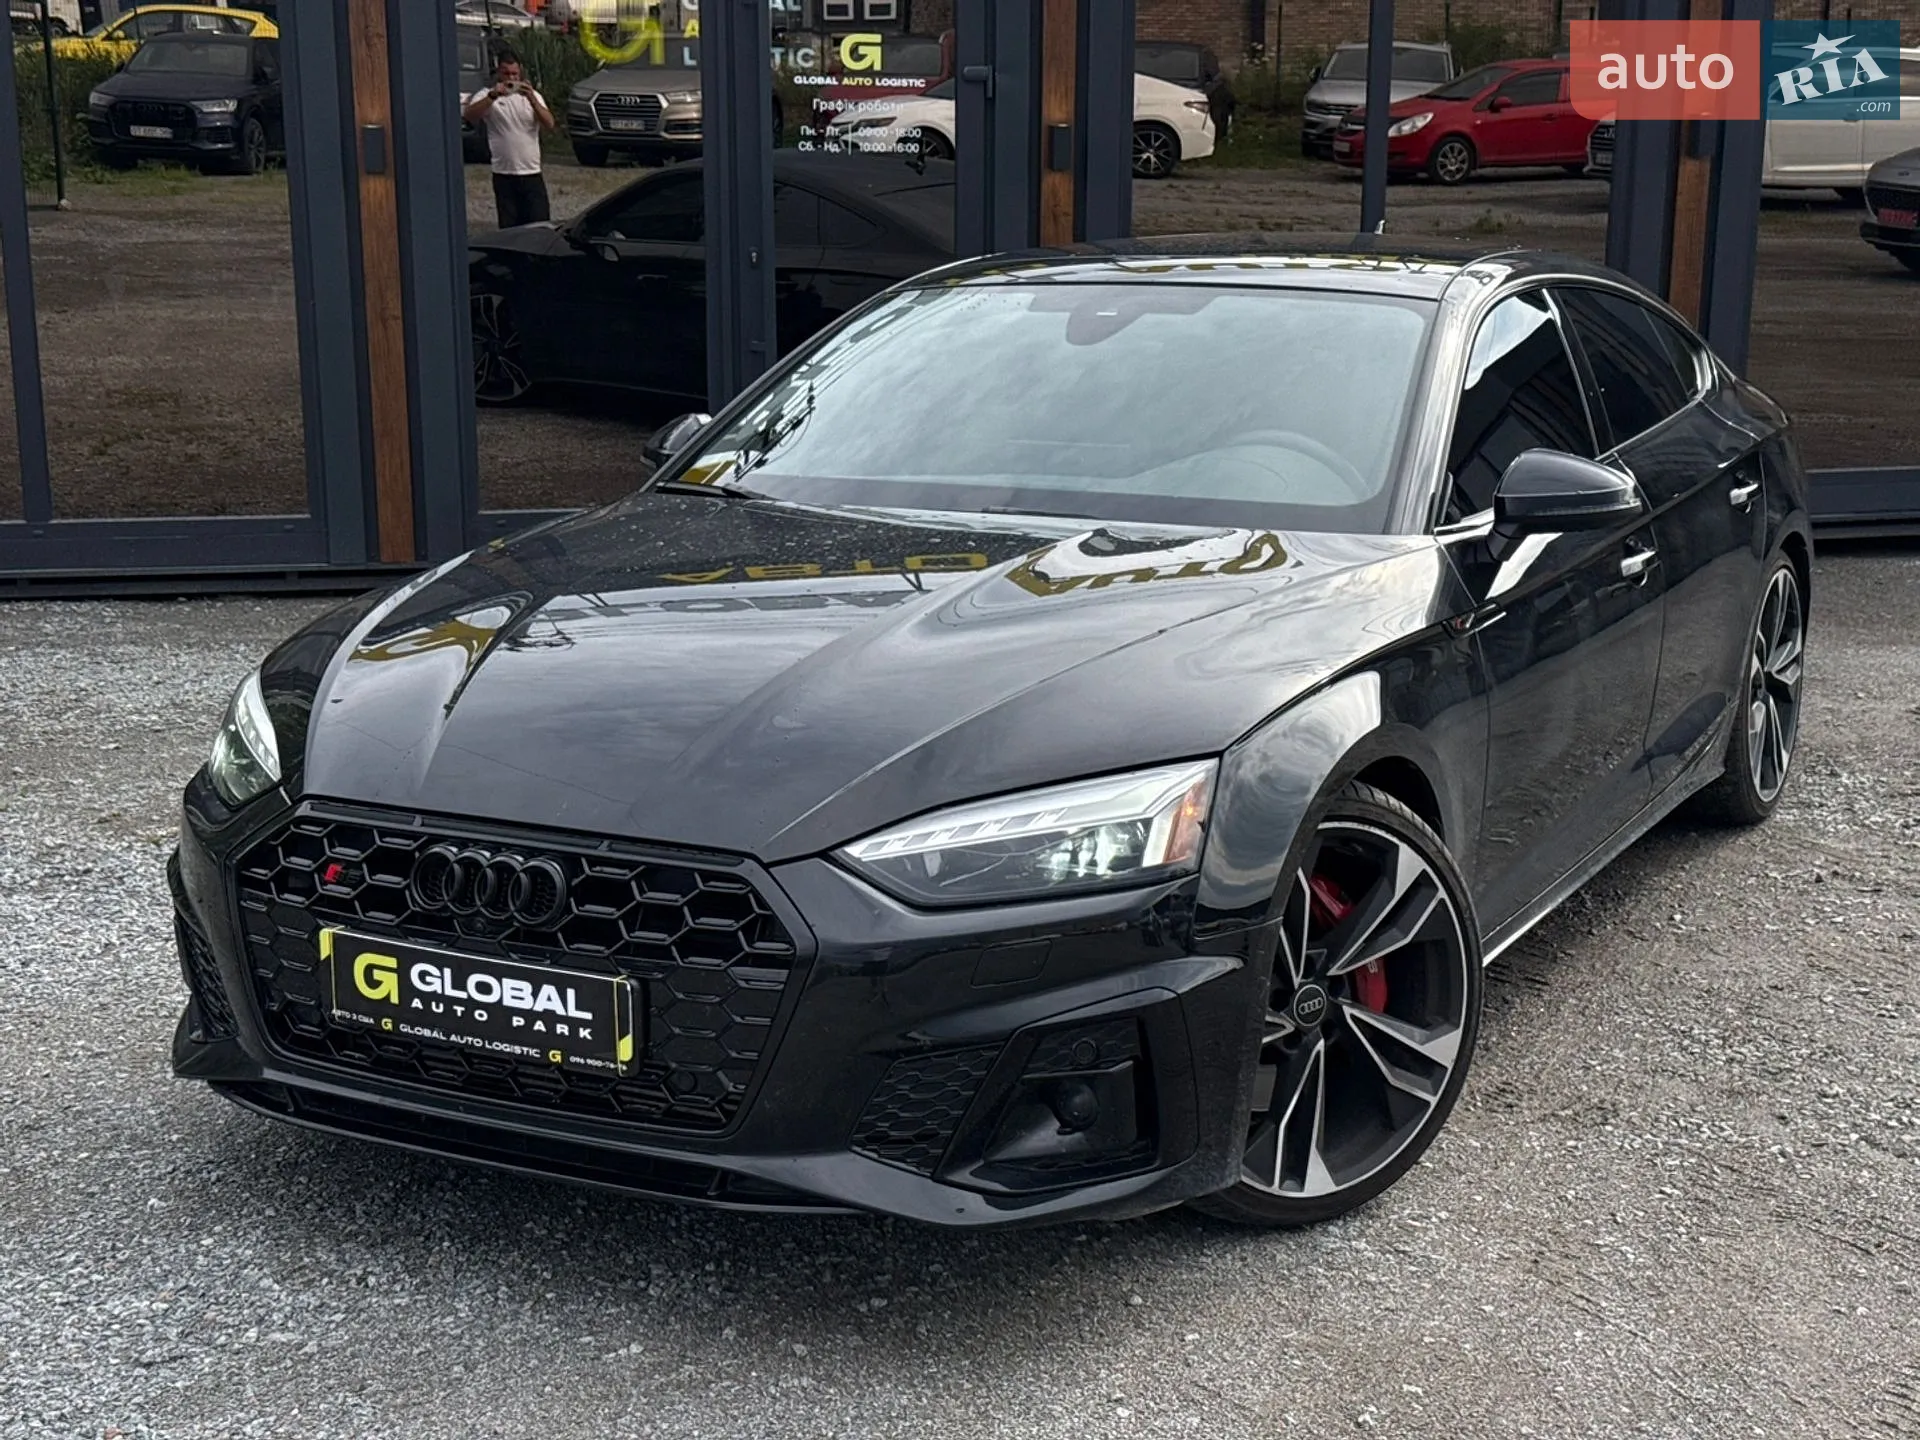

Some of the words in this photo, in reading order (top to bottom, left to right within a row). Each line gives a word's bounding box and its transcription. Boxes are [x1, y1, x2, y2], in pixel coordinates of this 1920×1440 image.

[793, 75, 839, 86] GLOBAL
[841, 77, 873, 87] AUTO
[875, 77, 927, 88] LOGISTIC
[812, 98, 855, 113] Графік
[410, 962, 593, 1021] GLOBAL
[410, 997, 488, 1021] AUTO
[511, 1015, 593, 1040] PARK
[399, 1023, 449, 1041] GLOBAL
[449, 1033, 483, 1047] AUTO
[484, 1038, 541, 1058] LOGISTIC
